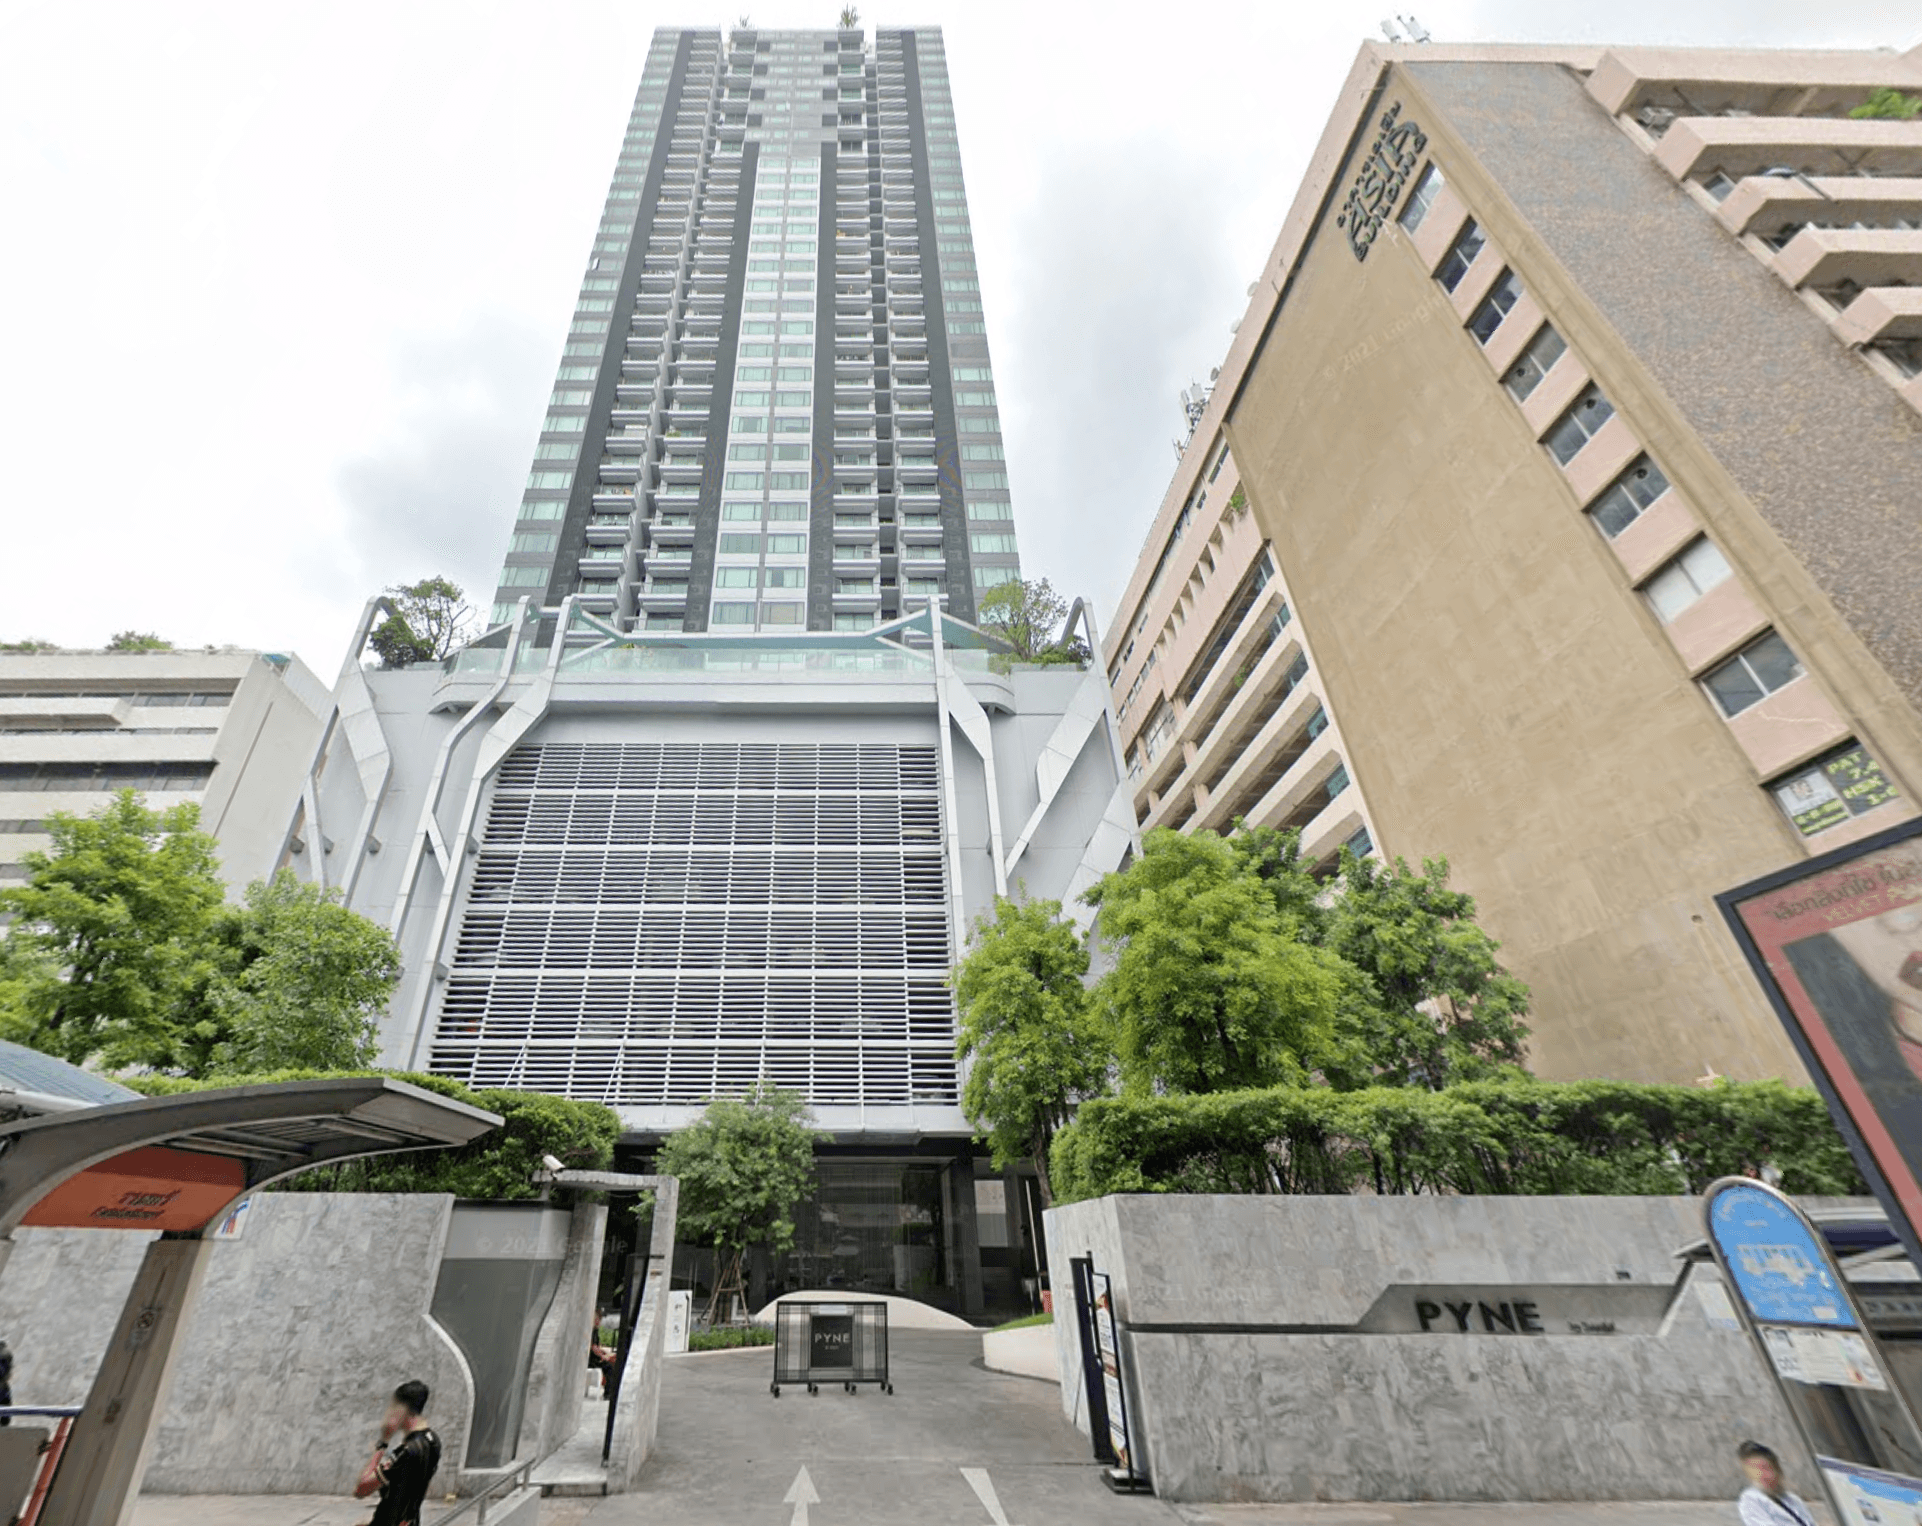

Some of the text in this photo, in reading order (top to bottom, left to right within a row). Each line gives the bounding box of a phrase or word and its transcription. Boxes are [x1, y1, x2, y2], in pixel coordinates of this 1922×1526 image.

[1347, 121, 1420, 246] ASIA
[1355, 133, 1428, 263] BUILDING
[814, 1332, 852, 1344] PYNE
[1416, 1300, 1545, 1333] PYNE
